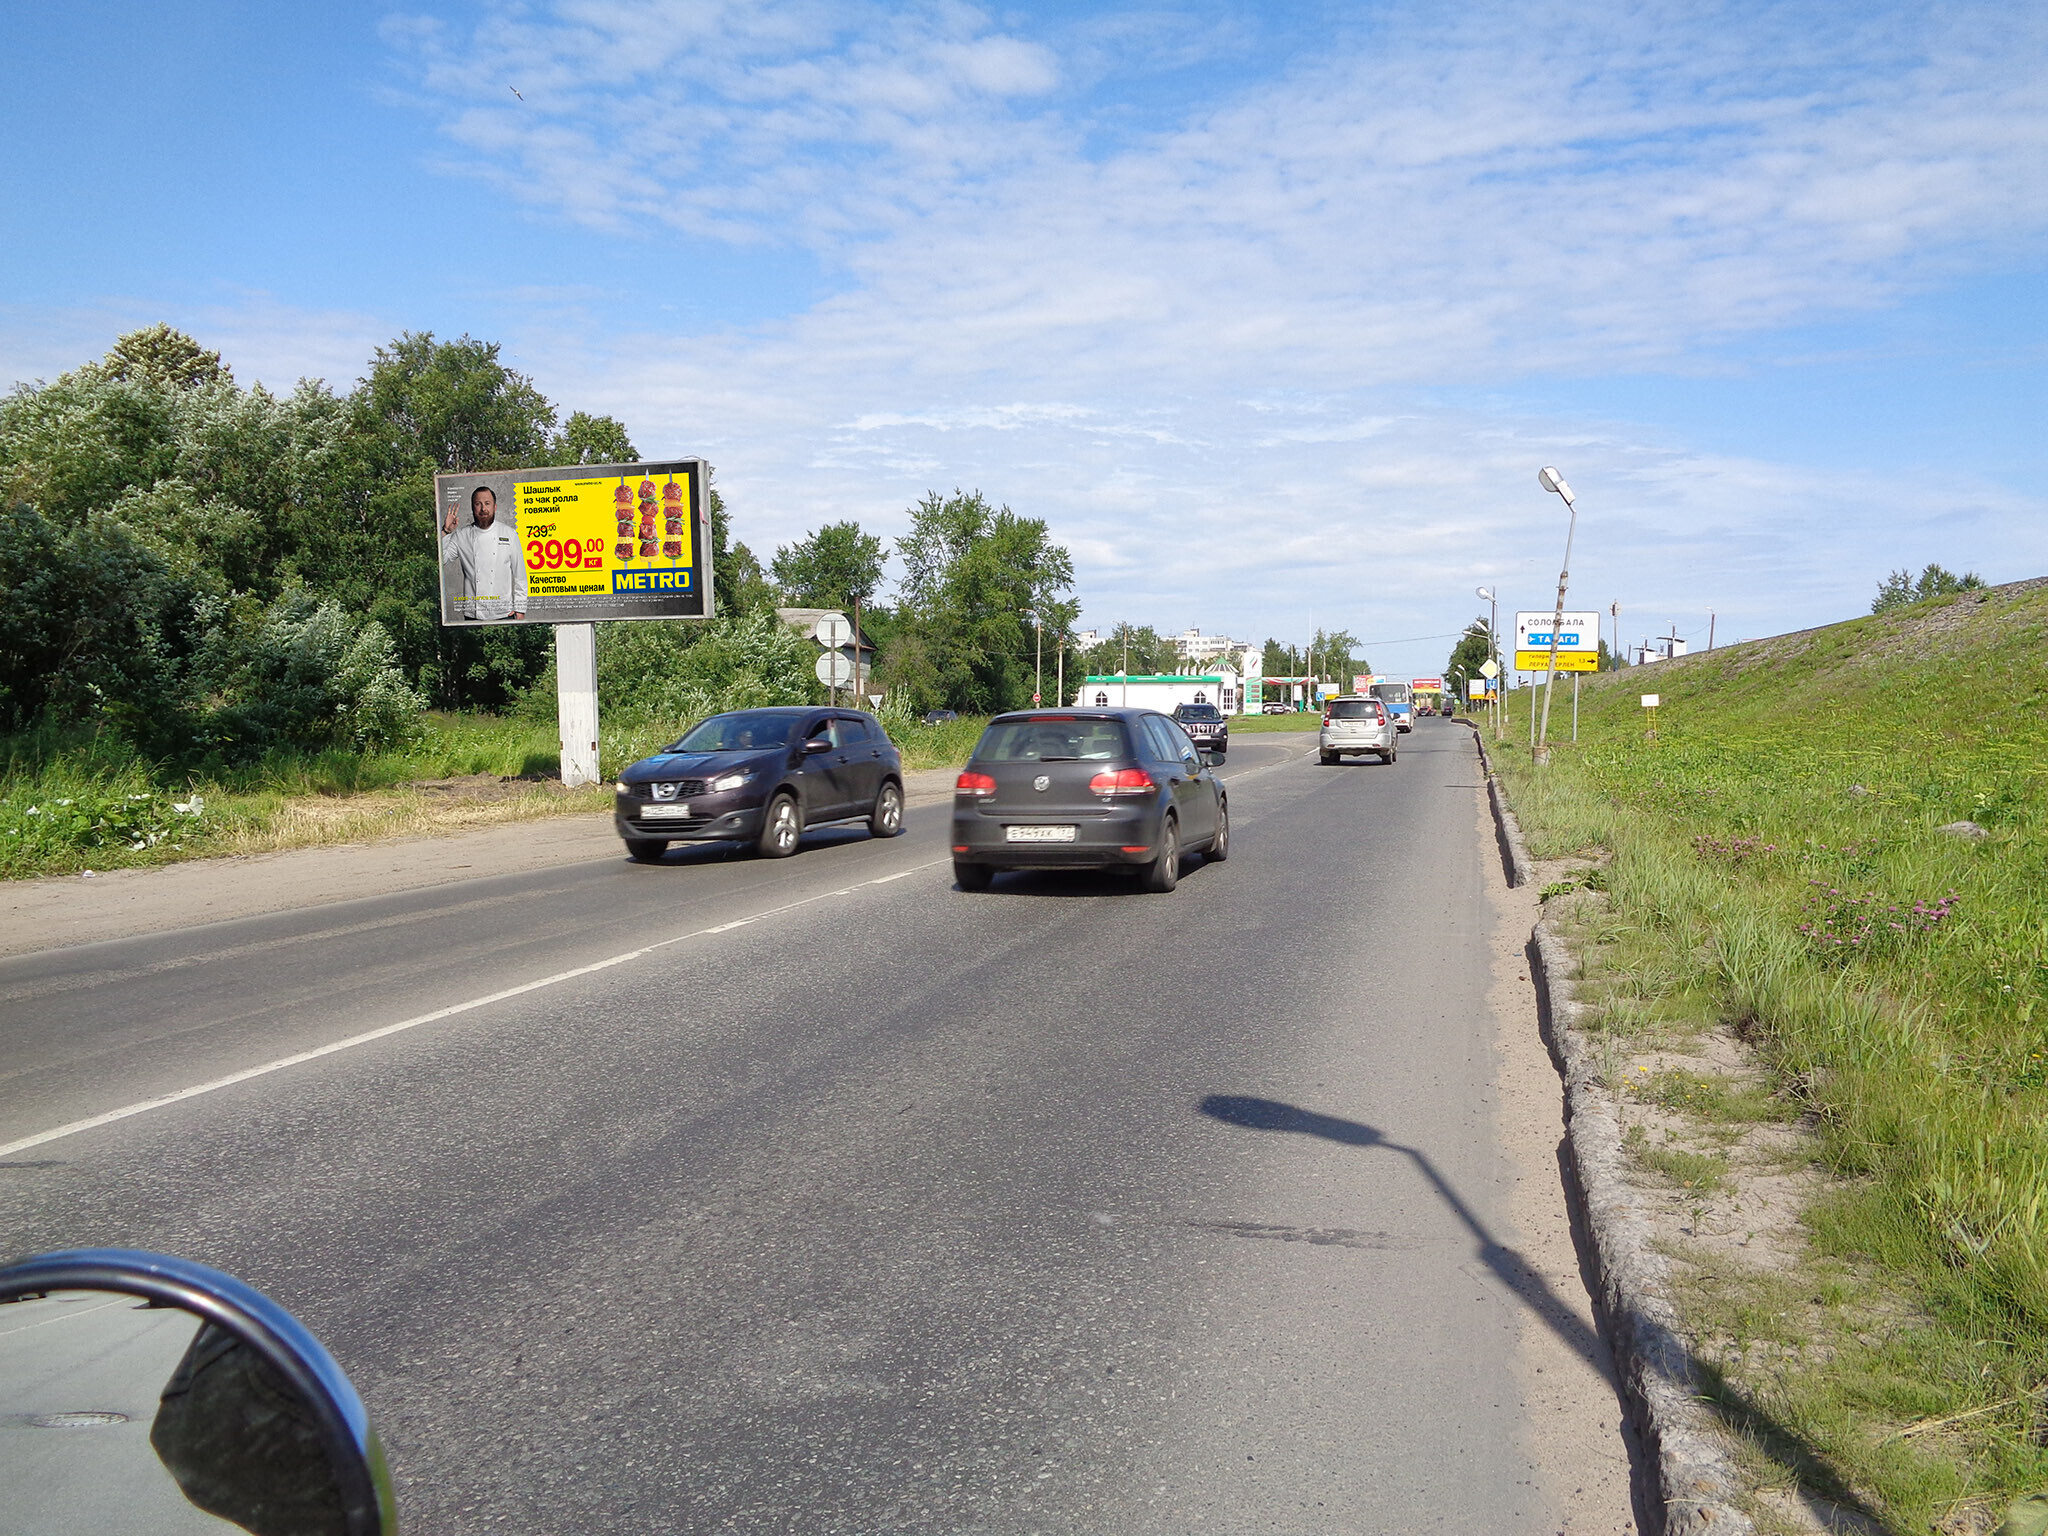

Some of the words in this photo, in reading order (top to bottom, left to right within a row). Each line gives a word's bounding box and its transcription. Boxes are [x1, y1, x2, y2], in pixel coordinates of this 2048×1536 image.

[523, 486, 561, 495] Шашлык
[535, 496, 551, 504] чак
[552, 495, 578, 504] ролла
[524, 504, 560, 514] говяжий
[529, 575, 566, 584] Качество
[615, 571, 690, 590] METRO
[530, 586, 540, 594] по
[541, 584, 577, 593] оптовым
[579, 583, 605, 593] ценам
[1538, 635, 1577, 643] ТААГИ
